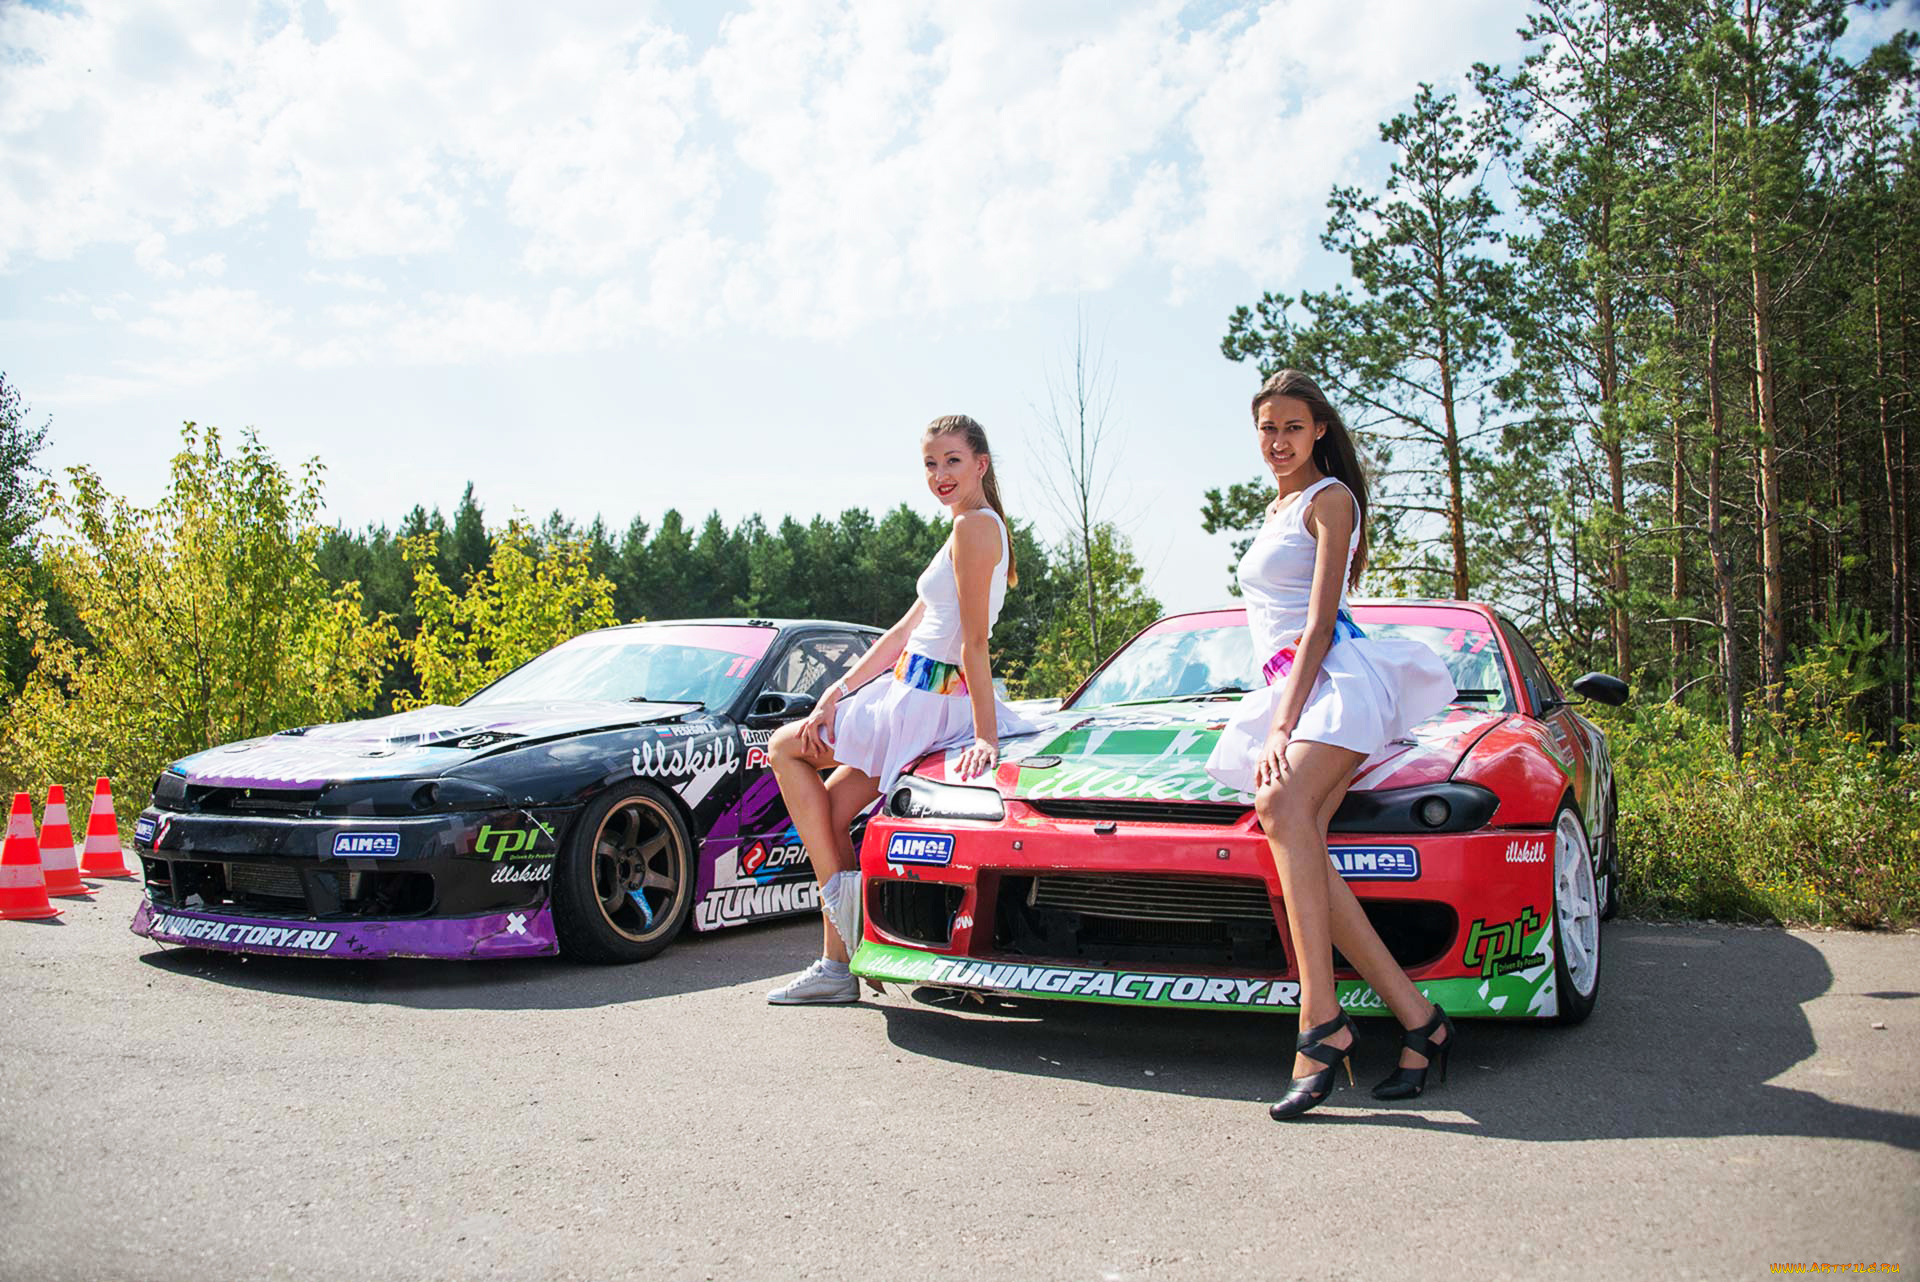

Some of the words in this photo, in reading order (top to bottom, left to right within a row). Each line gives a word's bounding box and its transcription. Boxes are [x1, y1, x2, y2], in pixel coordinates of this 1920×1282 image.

[1442, 630, 1491, 653] 47
[725, 657, 759, 679] 11
[743, 730, 775, 745] BRID
[632, 736, 740, 778] illskill
[1028, 766, 1256, 805] illski
[336, 838, 396, 852] AIMOL
[890, 839, 948, 858] AIMOL
[1505, 840, 1547, 863] illskill
[491, 863, 552, 883] illskill
[706, 881, 821, 921] TUNINGF
[149, 913, 339, 951] TUNINGFACTORY.RU
[929, 958, 1301, 1006] TUNINGFACTORY.R
